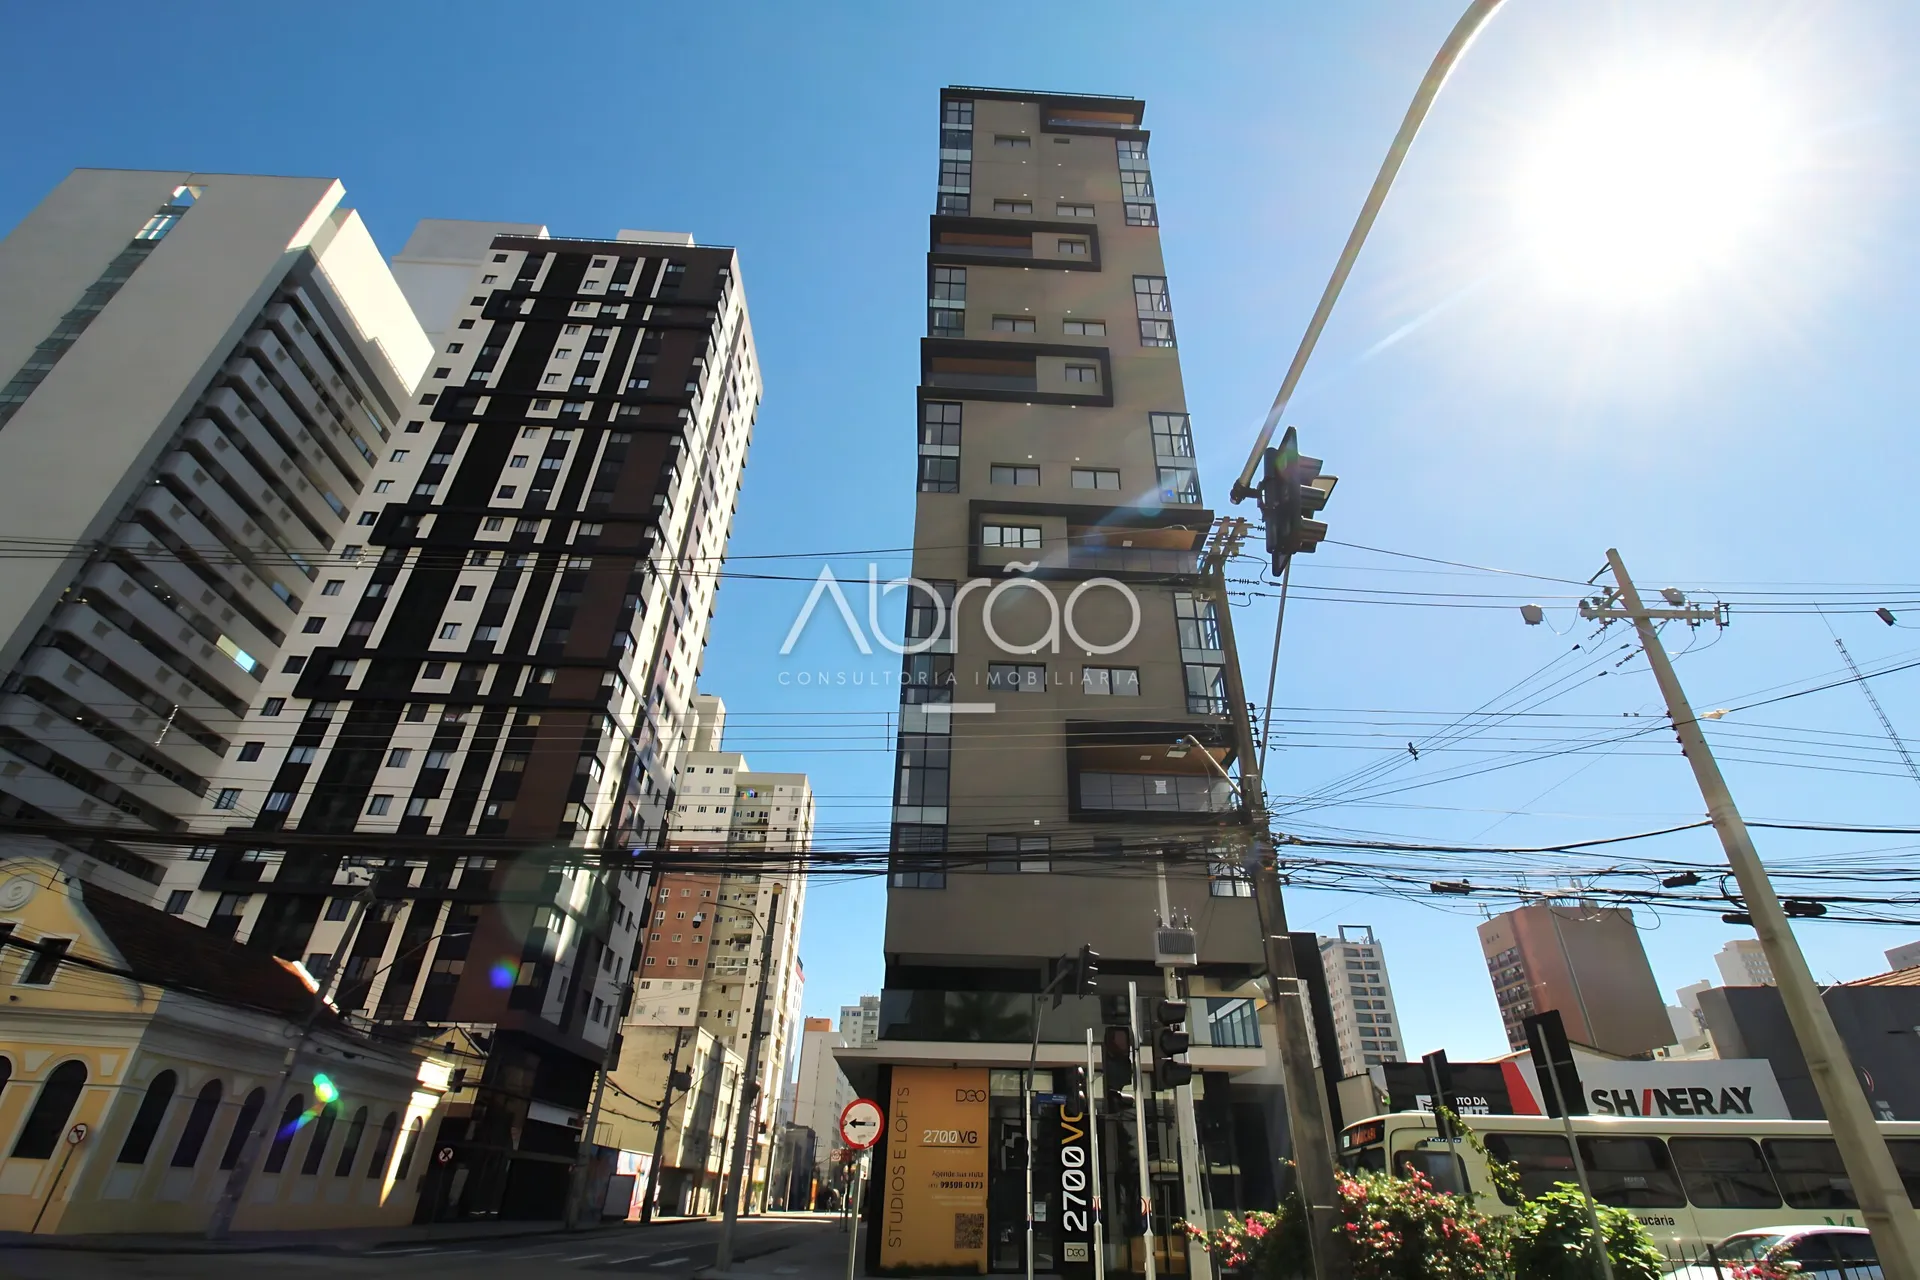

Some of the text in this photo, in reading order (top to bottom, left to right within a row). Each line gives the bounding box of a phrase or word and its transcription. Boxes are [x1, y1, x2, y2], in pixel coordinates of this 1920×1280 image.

[1473, 1096, 1488, 1105] DA
[1590, 1086, 1754, 1116] SHINERAY
[923, 1129, 978, 1144] 2700VG
[888, 1087, 910, 1248] STUDIOS E LOFTS
